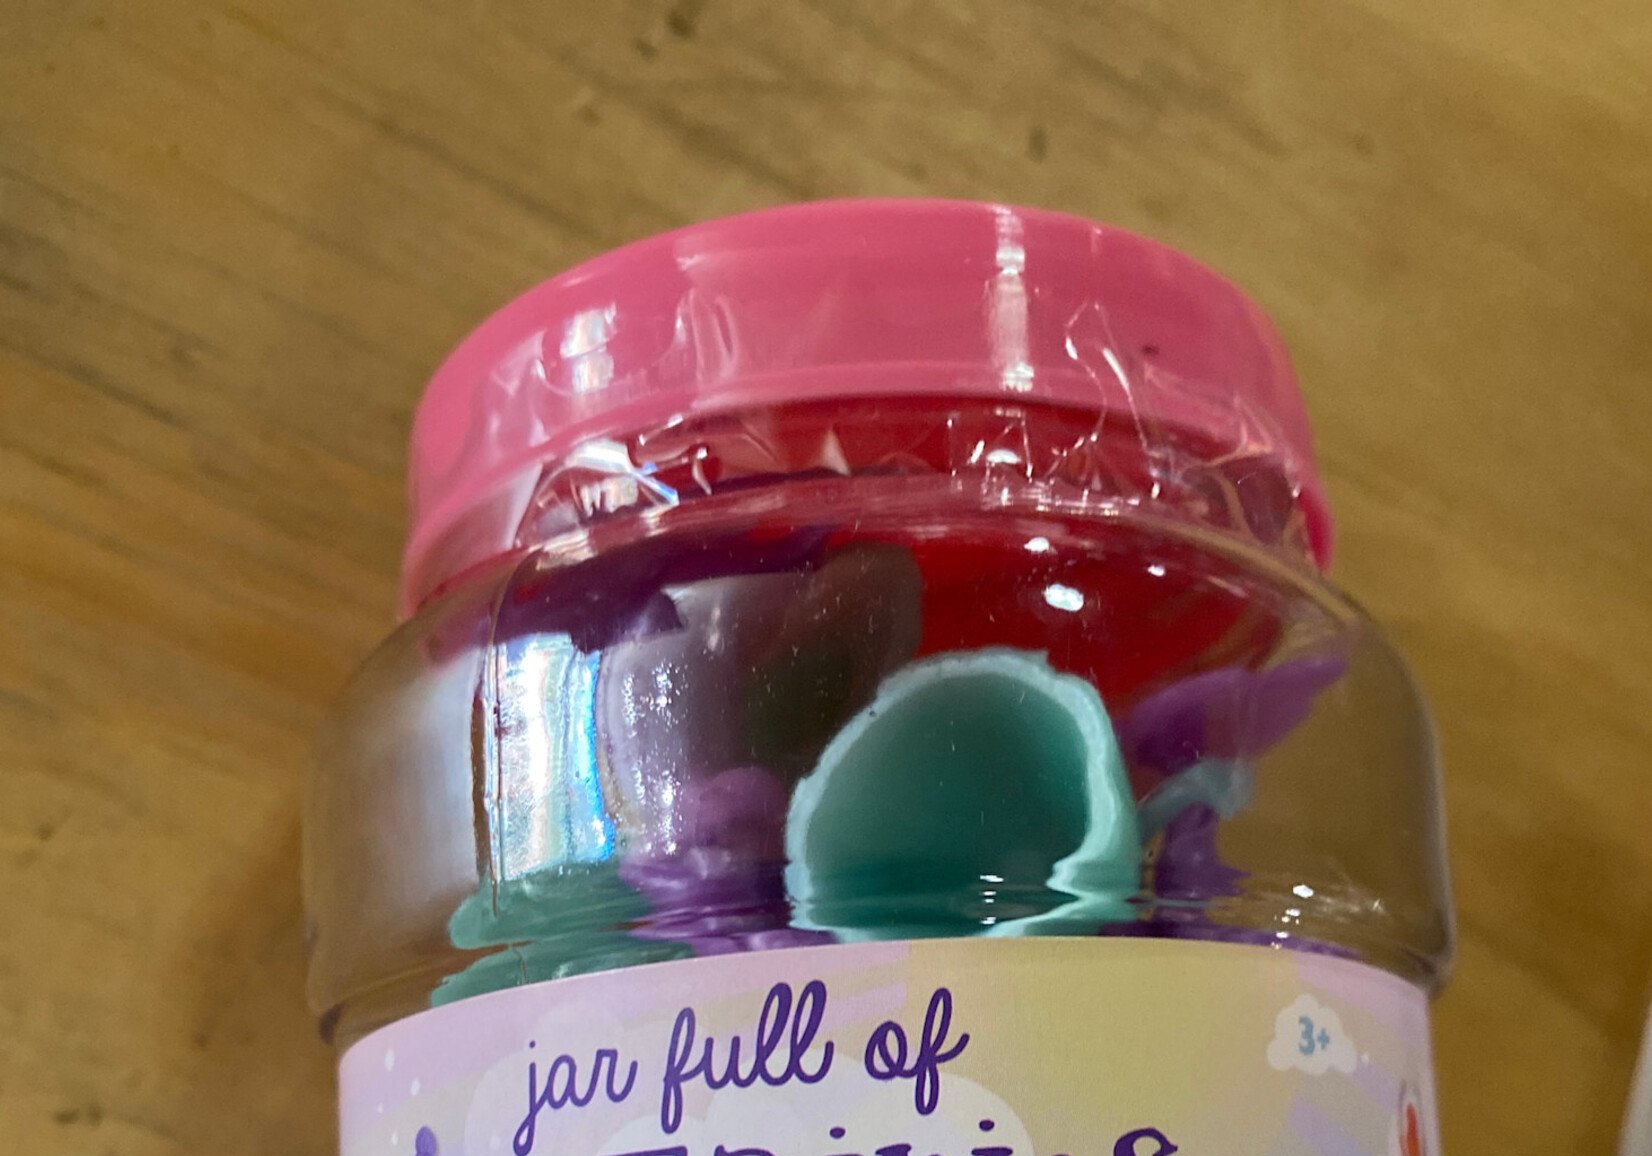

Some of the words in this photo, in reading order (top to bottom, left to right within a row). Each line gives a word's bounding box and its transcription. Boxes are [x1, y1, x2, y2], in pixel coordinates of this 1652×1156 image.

[660, 979, 834, 1134] full
[864, 987, 970, 1116] of
[1298, 1016, 1331, 1056] 3+
